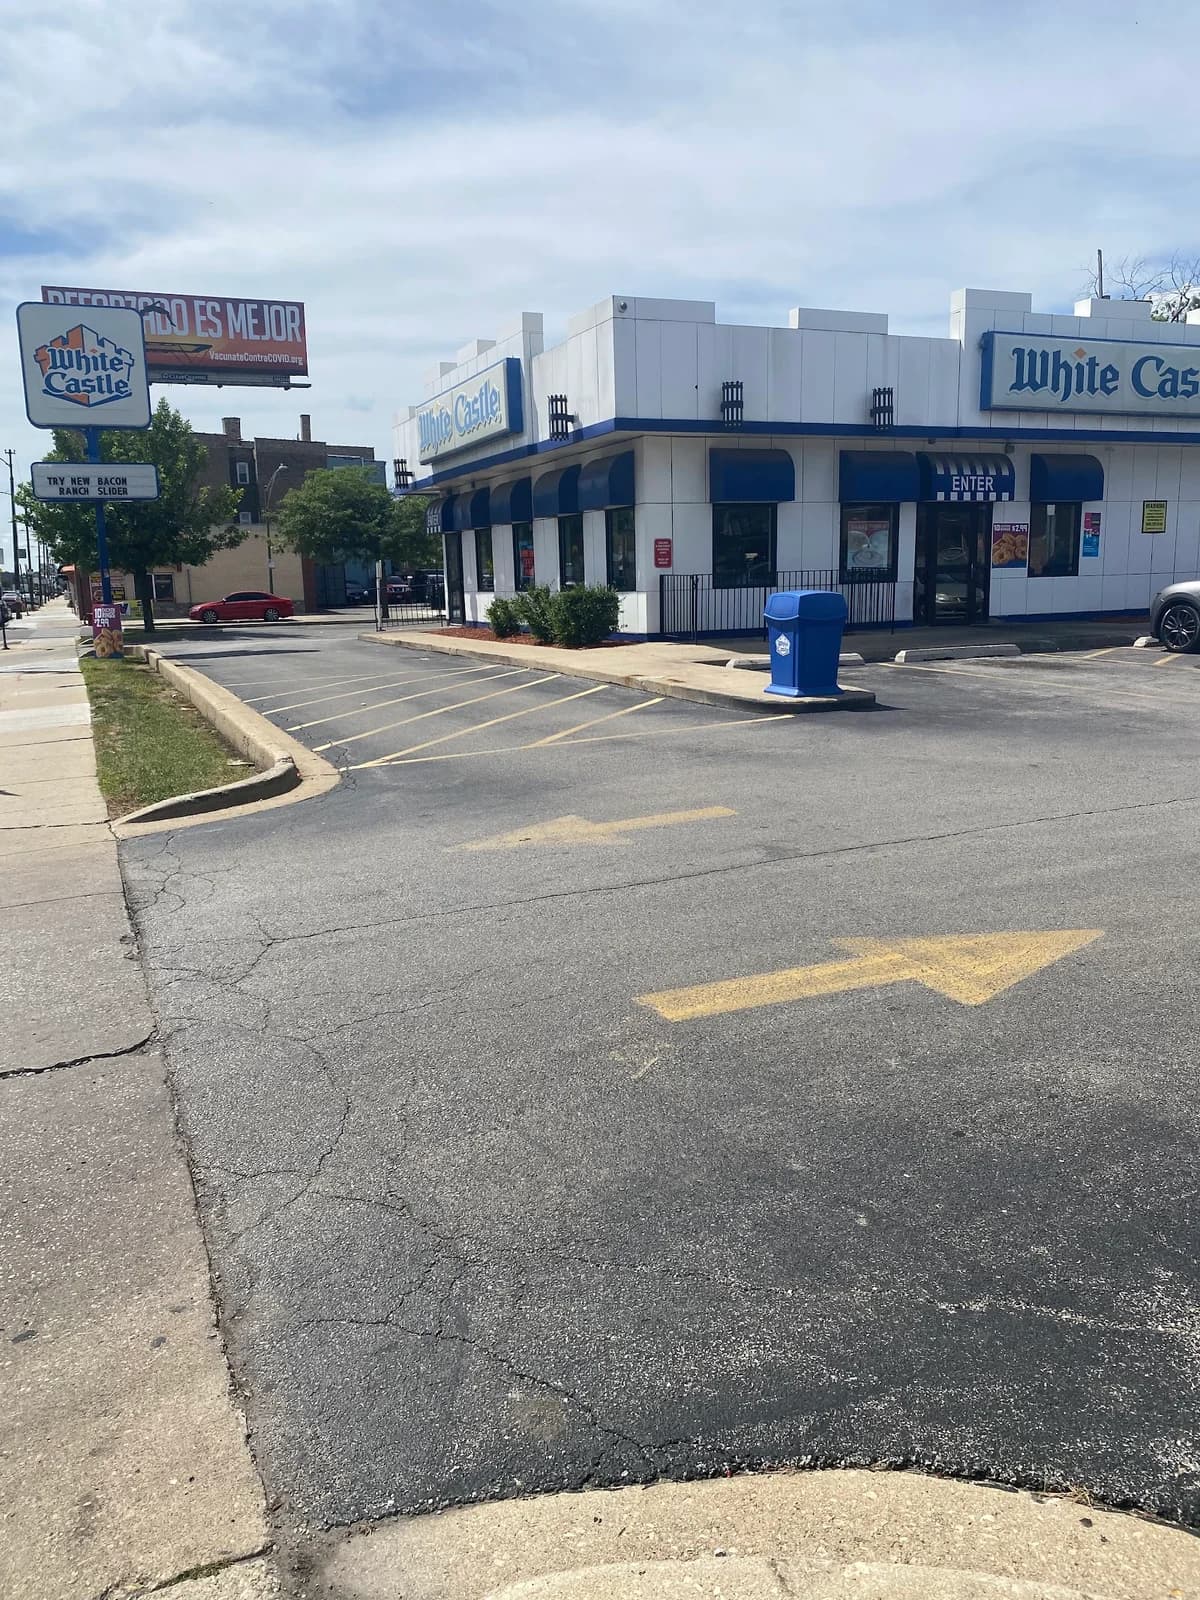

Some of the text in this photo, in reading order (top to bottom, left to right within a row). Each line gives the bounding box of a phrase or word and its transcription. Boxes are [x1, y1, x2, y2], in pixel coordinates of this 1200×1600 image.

[195, 299, 223, 338] ES
[227, 303, 302, 343] MEJOR
[48, 348, 126, 374] White
[44, 372, 129, 395] Castle
[1010, 347, 1120, 402] White
[419, 381, 499, 452] White Castle
[48, 477, 127, 486] TRY NEW BACON
[59, 487, 128, 495] RANCH SLIDER
[953, 477, 993, 491] ENTER
[95, 608, 102, 618] 10
